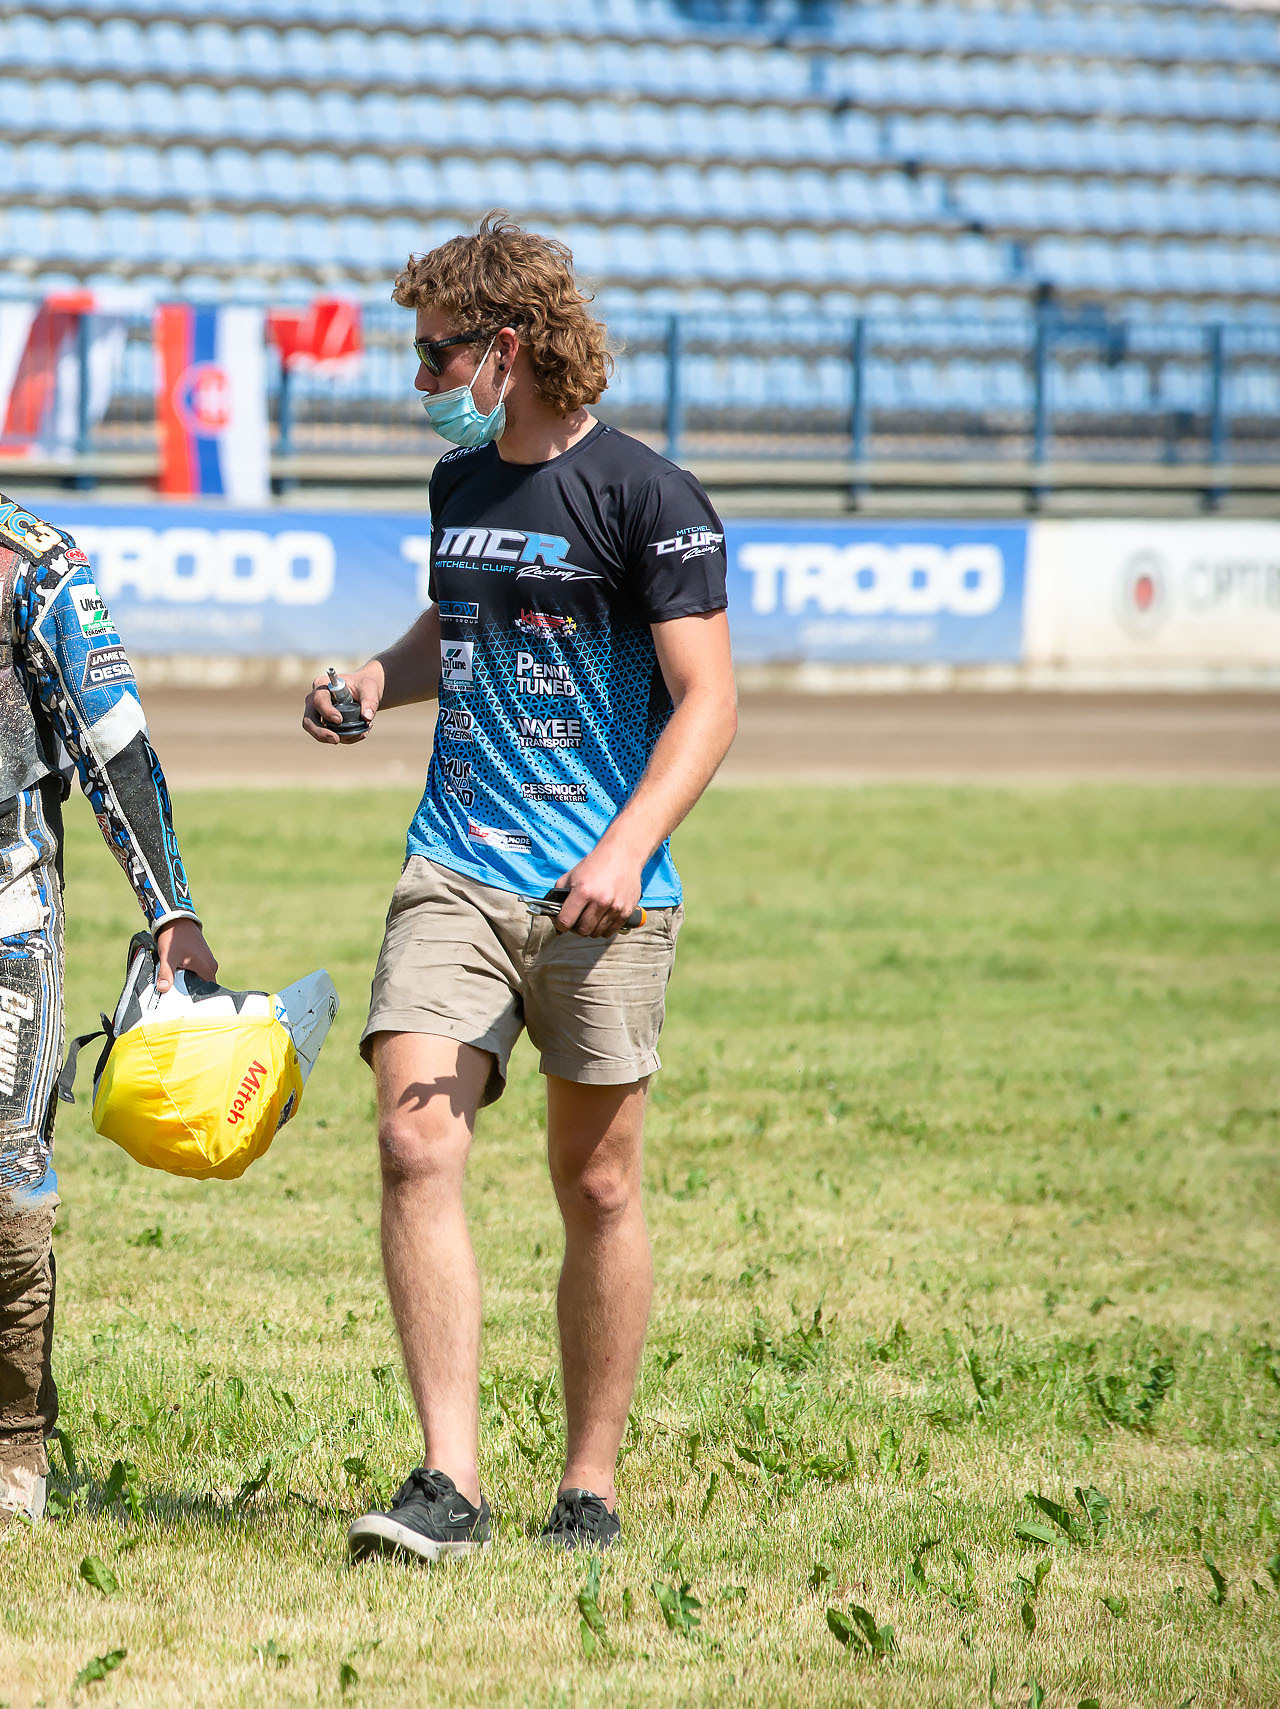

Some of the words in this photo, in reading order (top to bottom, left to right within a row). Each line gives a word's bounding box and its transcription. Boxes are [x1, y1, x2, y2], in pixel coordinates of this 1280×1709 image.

[436, 527, 586, 570] MCR
[76, 526, 336, 604] RODO
[435, 560, 480, 570] MITCHELL
[482, 563, 516, 573] CLUFF
[515, 565, 606, 582] Racing
[738, 542, 1005, 616] TRODO
[80, 597, 107, 612] Ultra
[91, 652, 119, 666] JAMIE
[517, 652, 570, 680] PENNY
[517, 677, 576, 697] TUNED
[517, 718, 582, 738] WYEE
[519, 737, 581, 748] TRANSPORT
[521, 783, 586, 796] CESSNOCK
[554, 794, 587, 802] CENTRAL
[226, 1060, 268, 1125] Mitch
